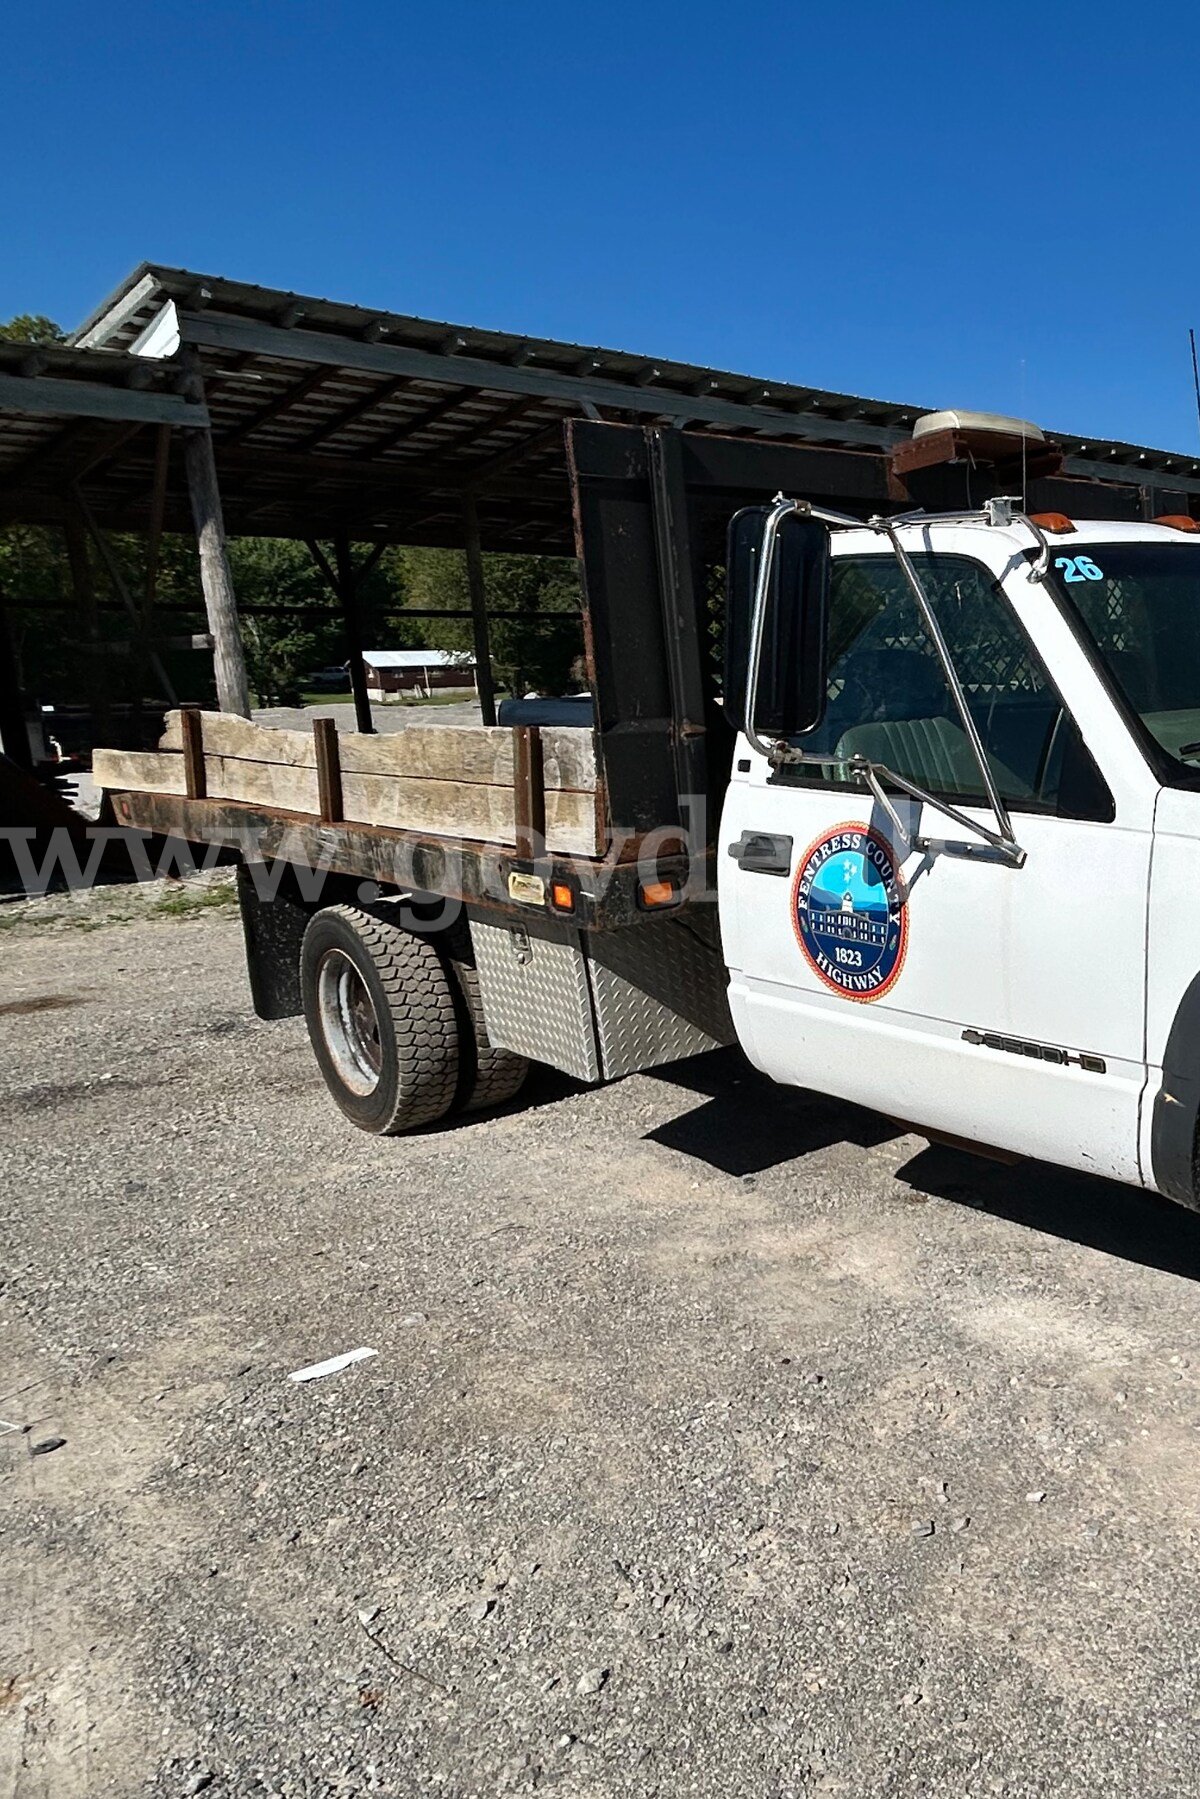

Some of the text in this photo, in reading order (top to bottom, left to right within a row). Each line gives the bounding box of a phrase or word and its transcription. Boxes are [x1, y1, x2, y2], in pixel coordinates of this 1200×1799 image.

[1055, 555, 1104, 583] 26
[797, 834, 901, 927] FENTRESS COUNTY
[815, 951, 885, 991] HIGHWAY
[835, 947, 863, 967] 1823
